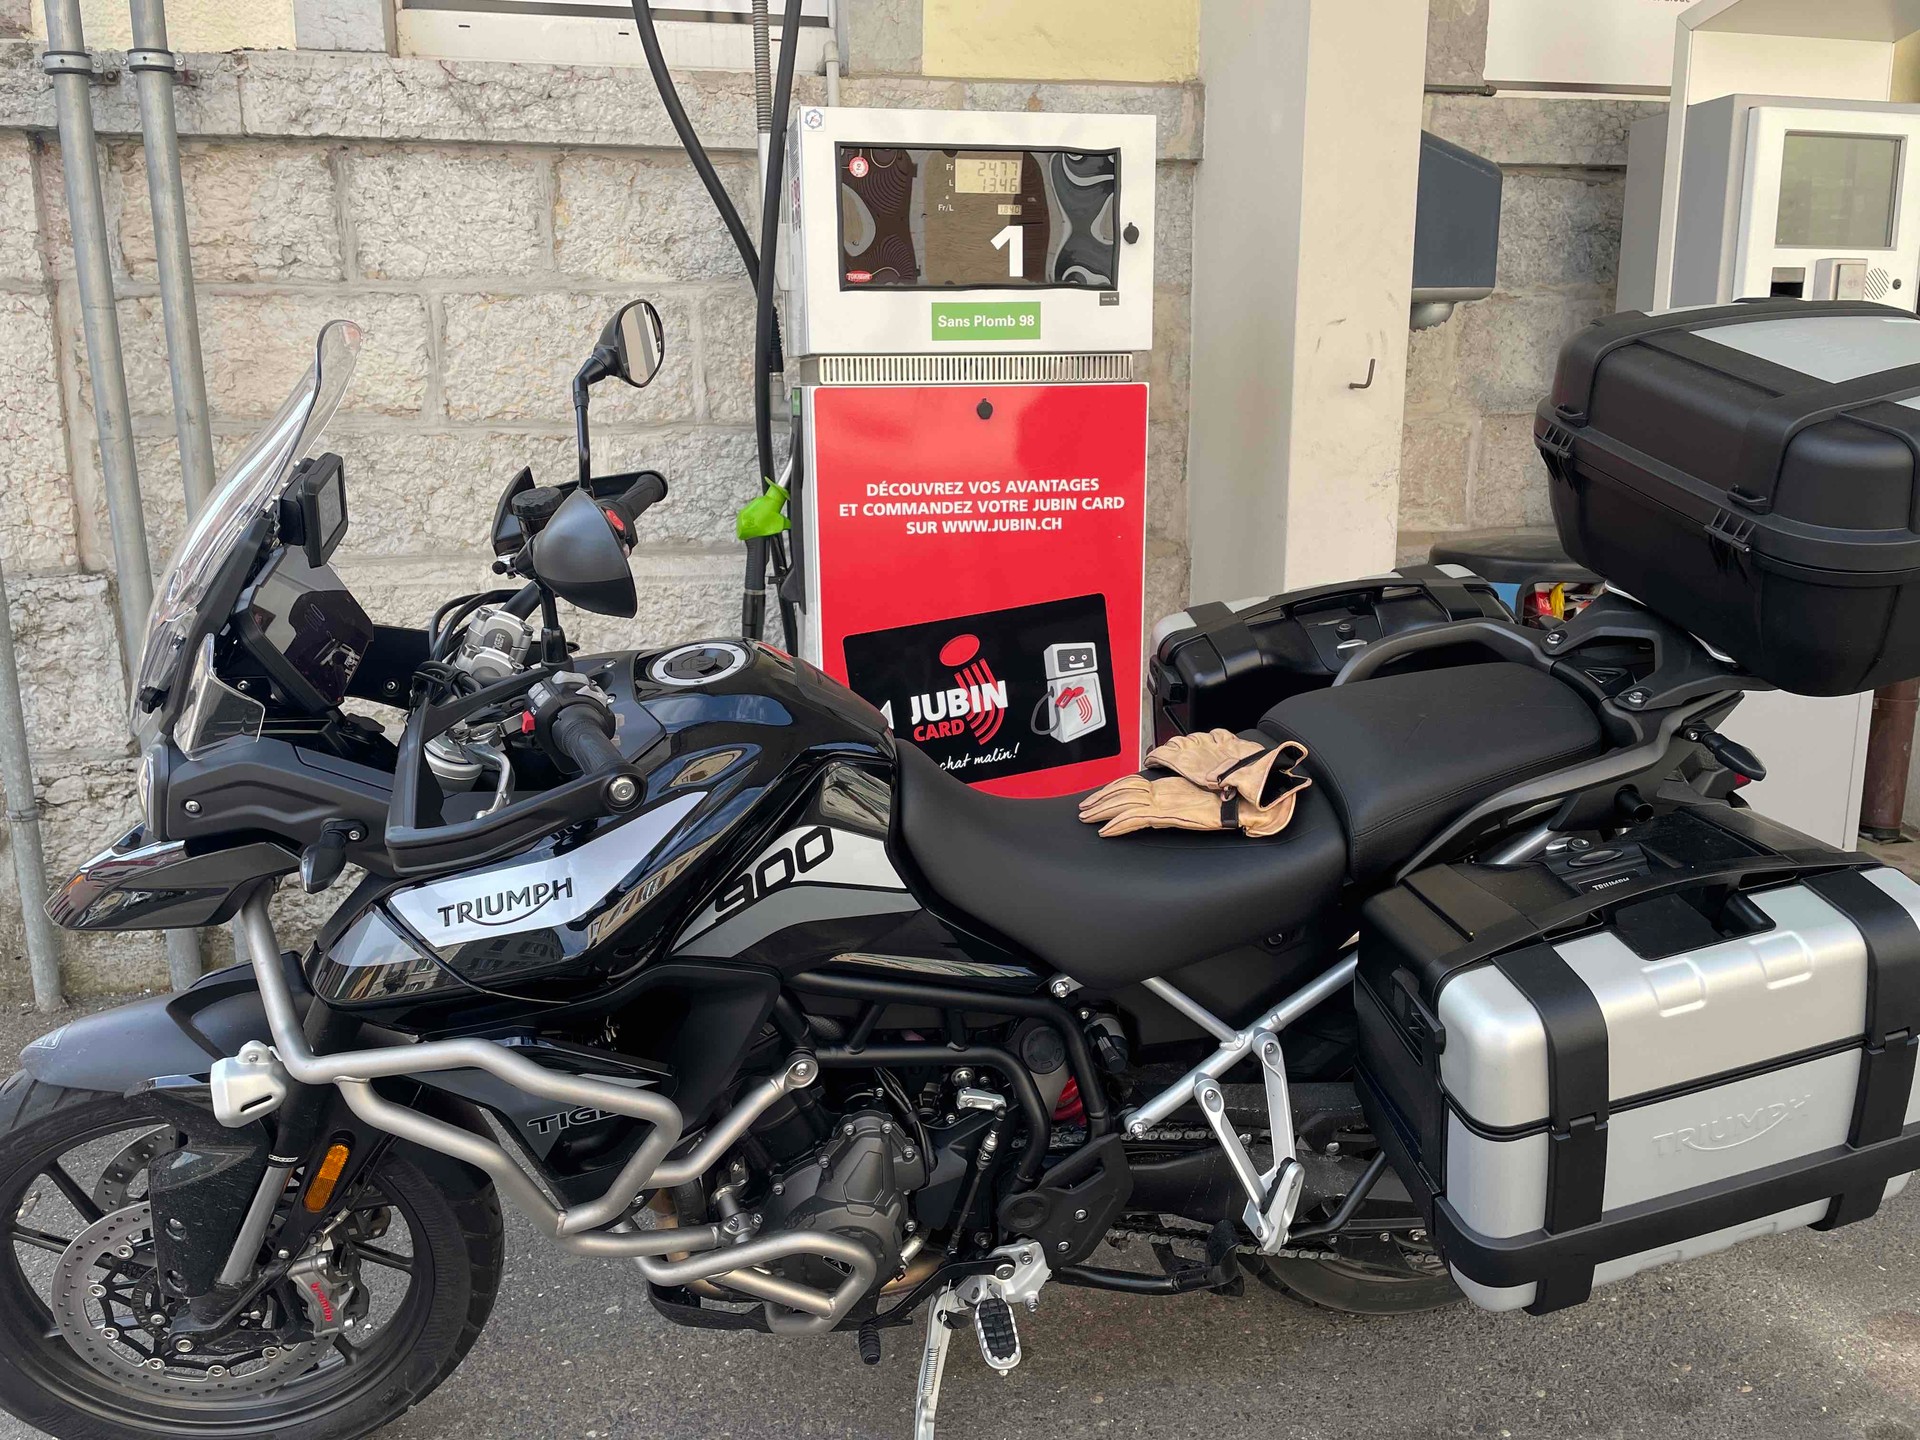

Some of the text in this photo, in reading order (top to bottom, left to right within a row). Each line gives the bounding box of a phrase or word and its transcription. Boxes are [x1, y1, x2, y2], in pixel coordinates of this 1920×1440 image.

[948, 179, 954, 187] L
[938, 203, 954, 212] Fr/L
[990, 225, 1024, 277] 1
[938, 314, 1035, 327] Sans Plomb 98
[866, 477, 1100, 497] DÉCOUVREZ VOS AVANTAGES
[839, 496, 1126, 517] ET COMMANDEZ VOTRE JUBIN CARD
[906, 517, 1063, 535] SUR WWW.JUBIN.CH
[910, 680, 1009, 726] JUBIN
[913, 718, 965, 742] CARD
[939, 741, 1021, 771] chat malin!
[714, 825, 834, 923] 900
[437, 877, 573, 927] TRIUMPH
[526, 1106, 621, 1135] TIG
[1652, 1094, 1812, 1158] TRIUMPH
